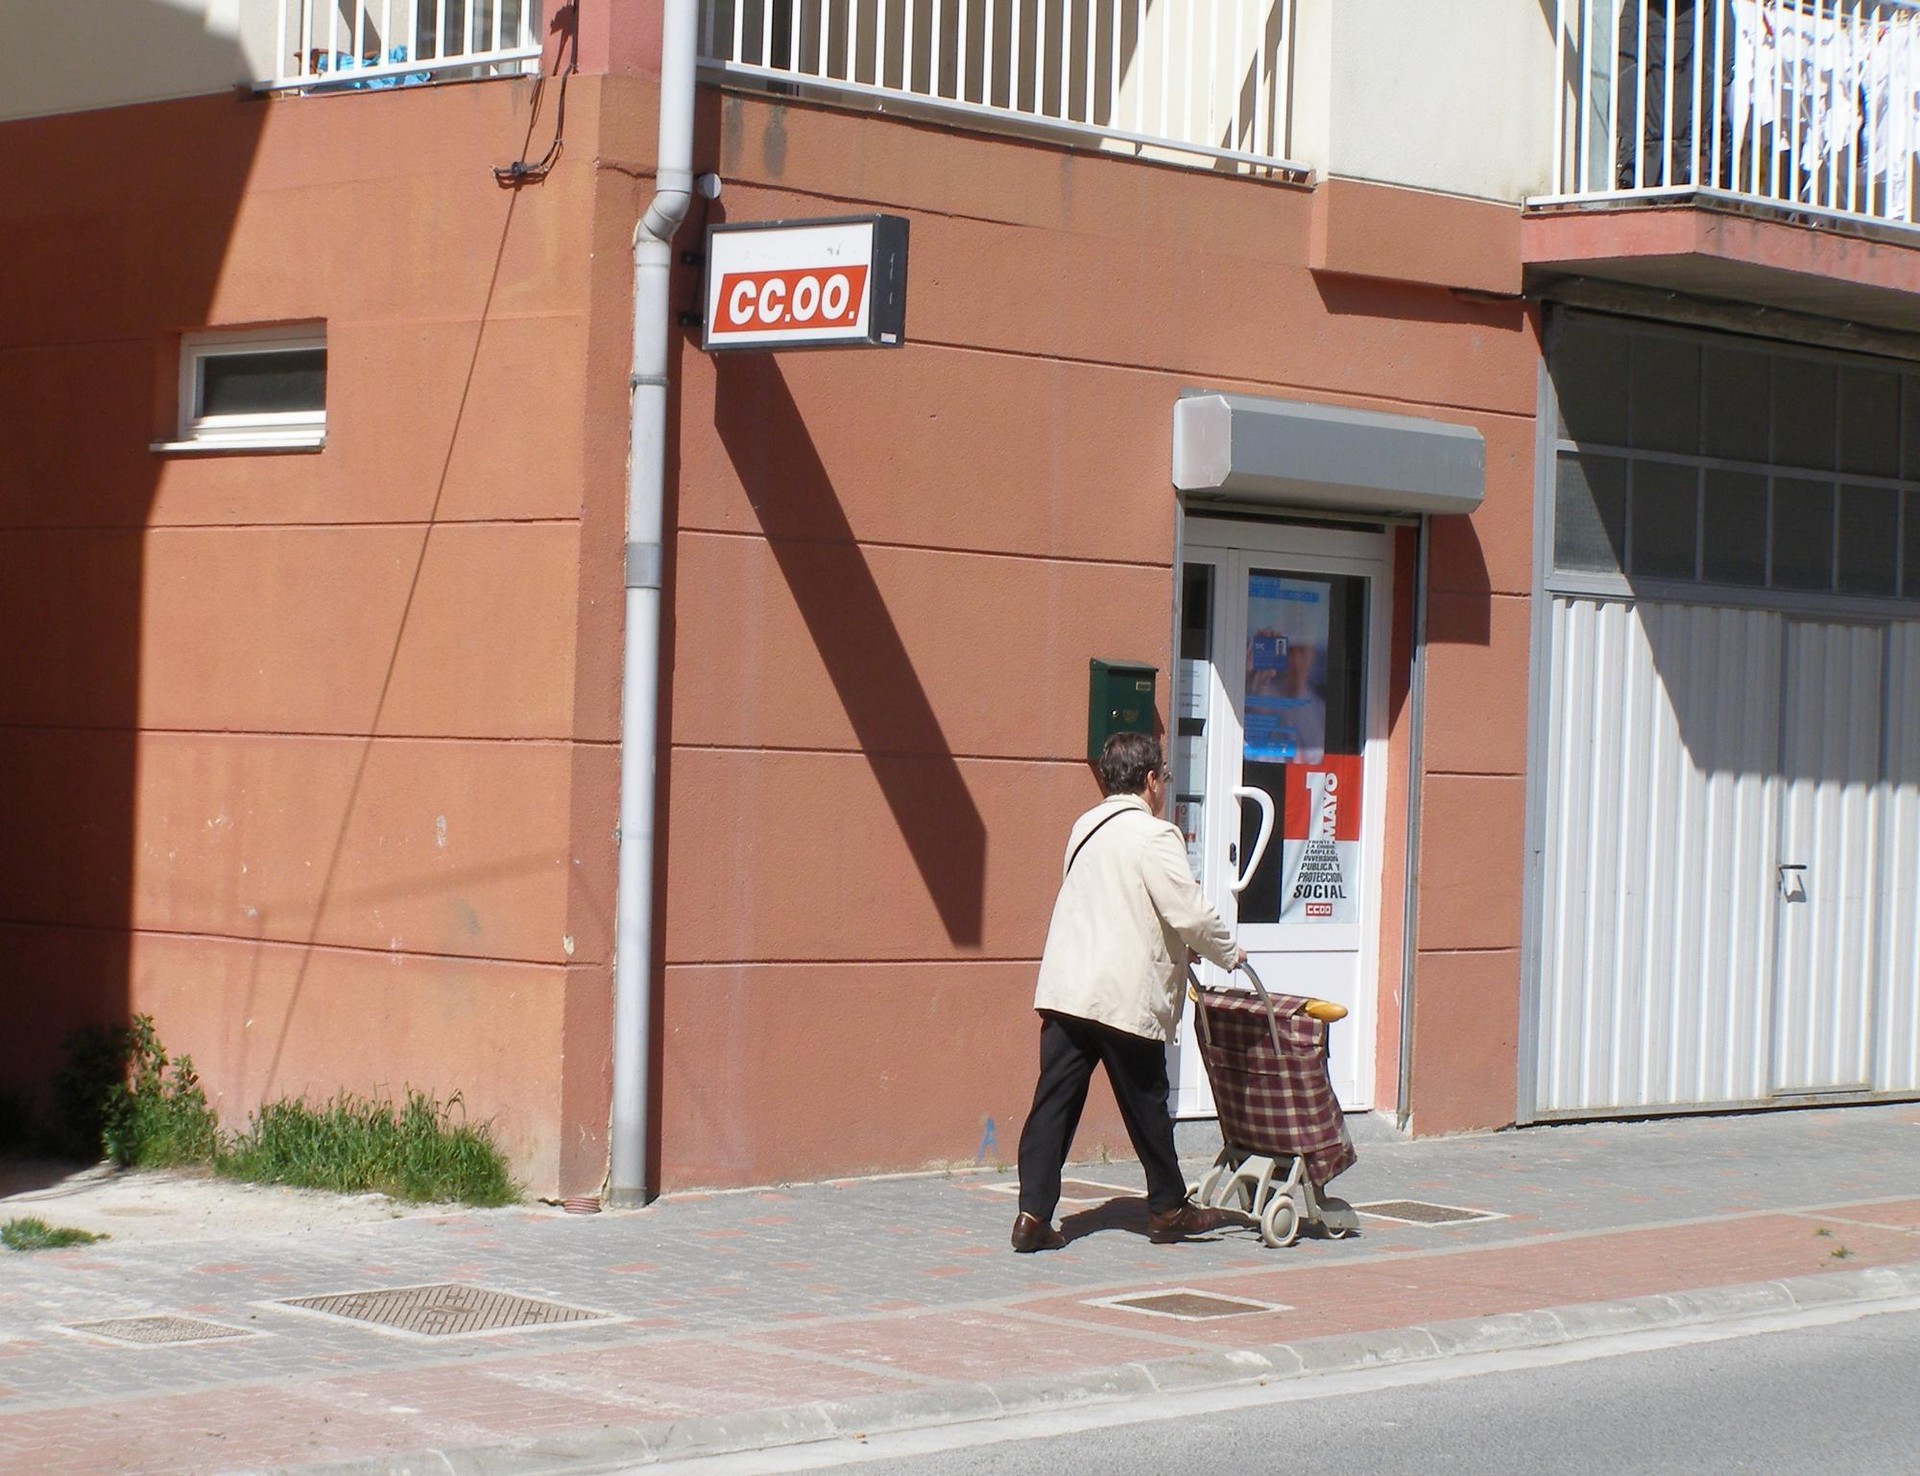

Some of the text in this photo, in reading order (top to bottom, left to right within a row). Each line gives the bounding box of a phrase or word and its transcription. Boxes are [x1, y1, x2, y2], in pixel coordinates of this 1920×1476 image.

[729, 274, 854, 325] CC.OO.
[1322, 772, 1338, 840] MAYO
[1335, 862, 1341, 871] Y
[1293, 884, 1347, 899] SOCIAL
[1307, 904, 1331, 915] CCOO
